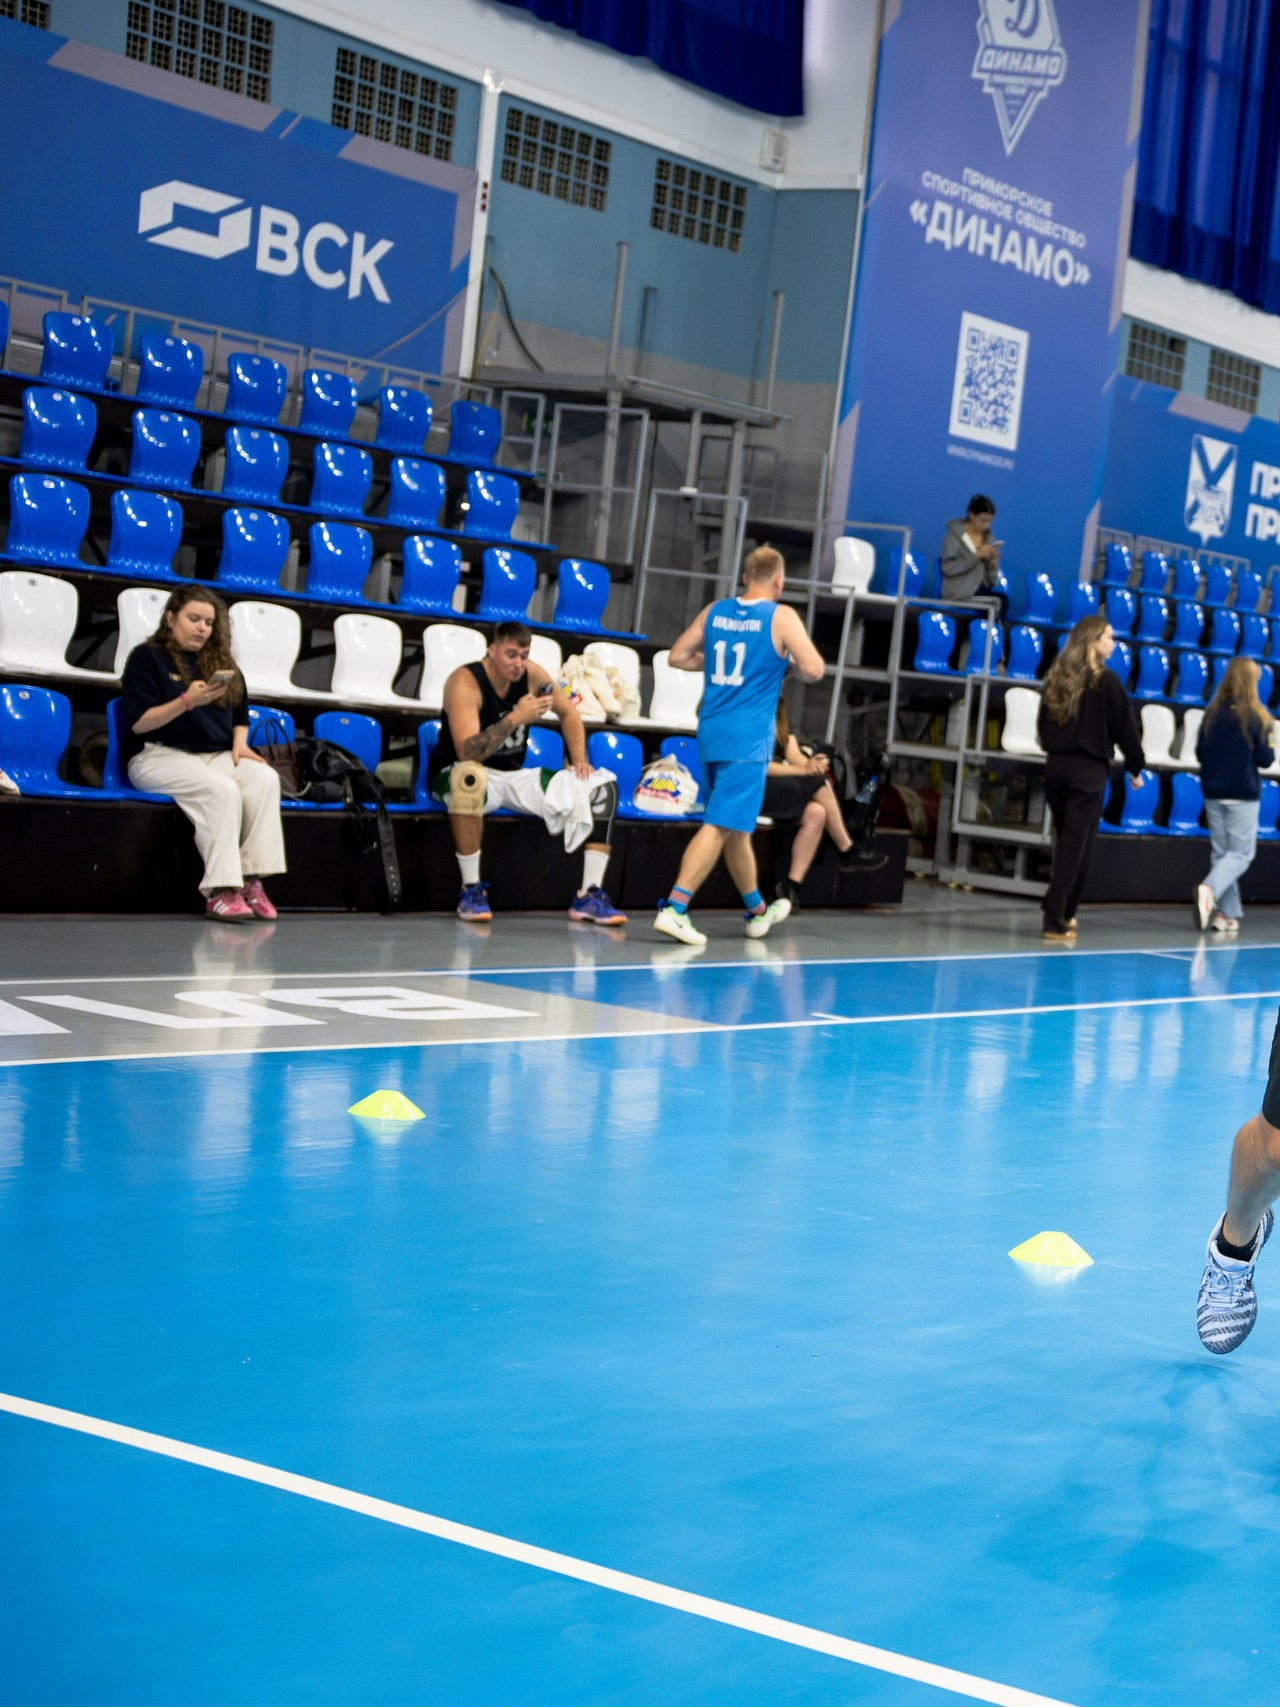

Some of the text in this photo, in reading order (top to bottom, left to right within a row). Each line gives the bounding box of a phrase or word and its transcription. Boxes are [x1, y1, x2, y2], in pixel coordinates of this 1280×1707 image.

[980, 48, 1061, 77] ДИНАМО
[922, 170, 1087, 249] СПОРТИВНОЕ ОБЩЕСТВО
[963, 167, 1053, 217] ПРИМОРСКОЕ
[256, 205, 394, 303] ВСК
[909, 199, 1091, 287] «ДИНАМО»
[711, 640, 746, 686] 11
